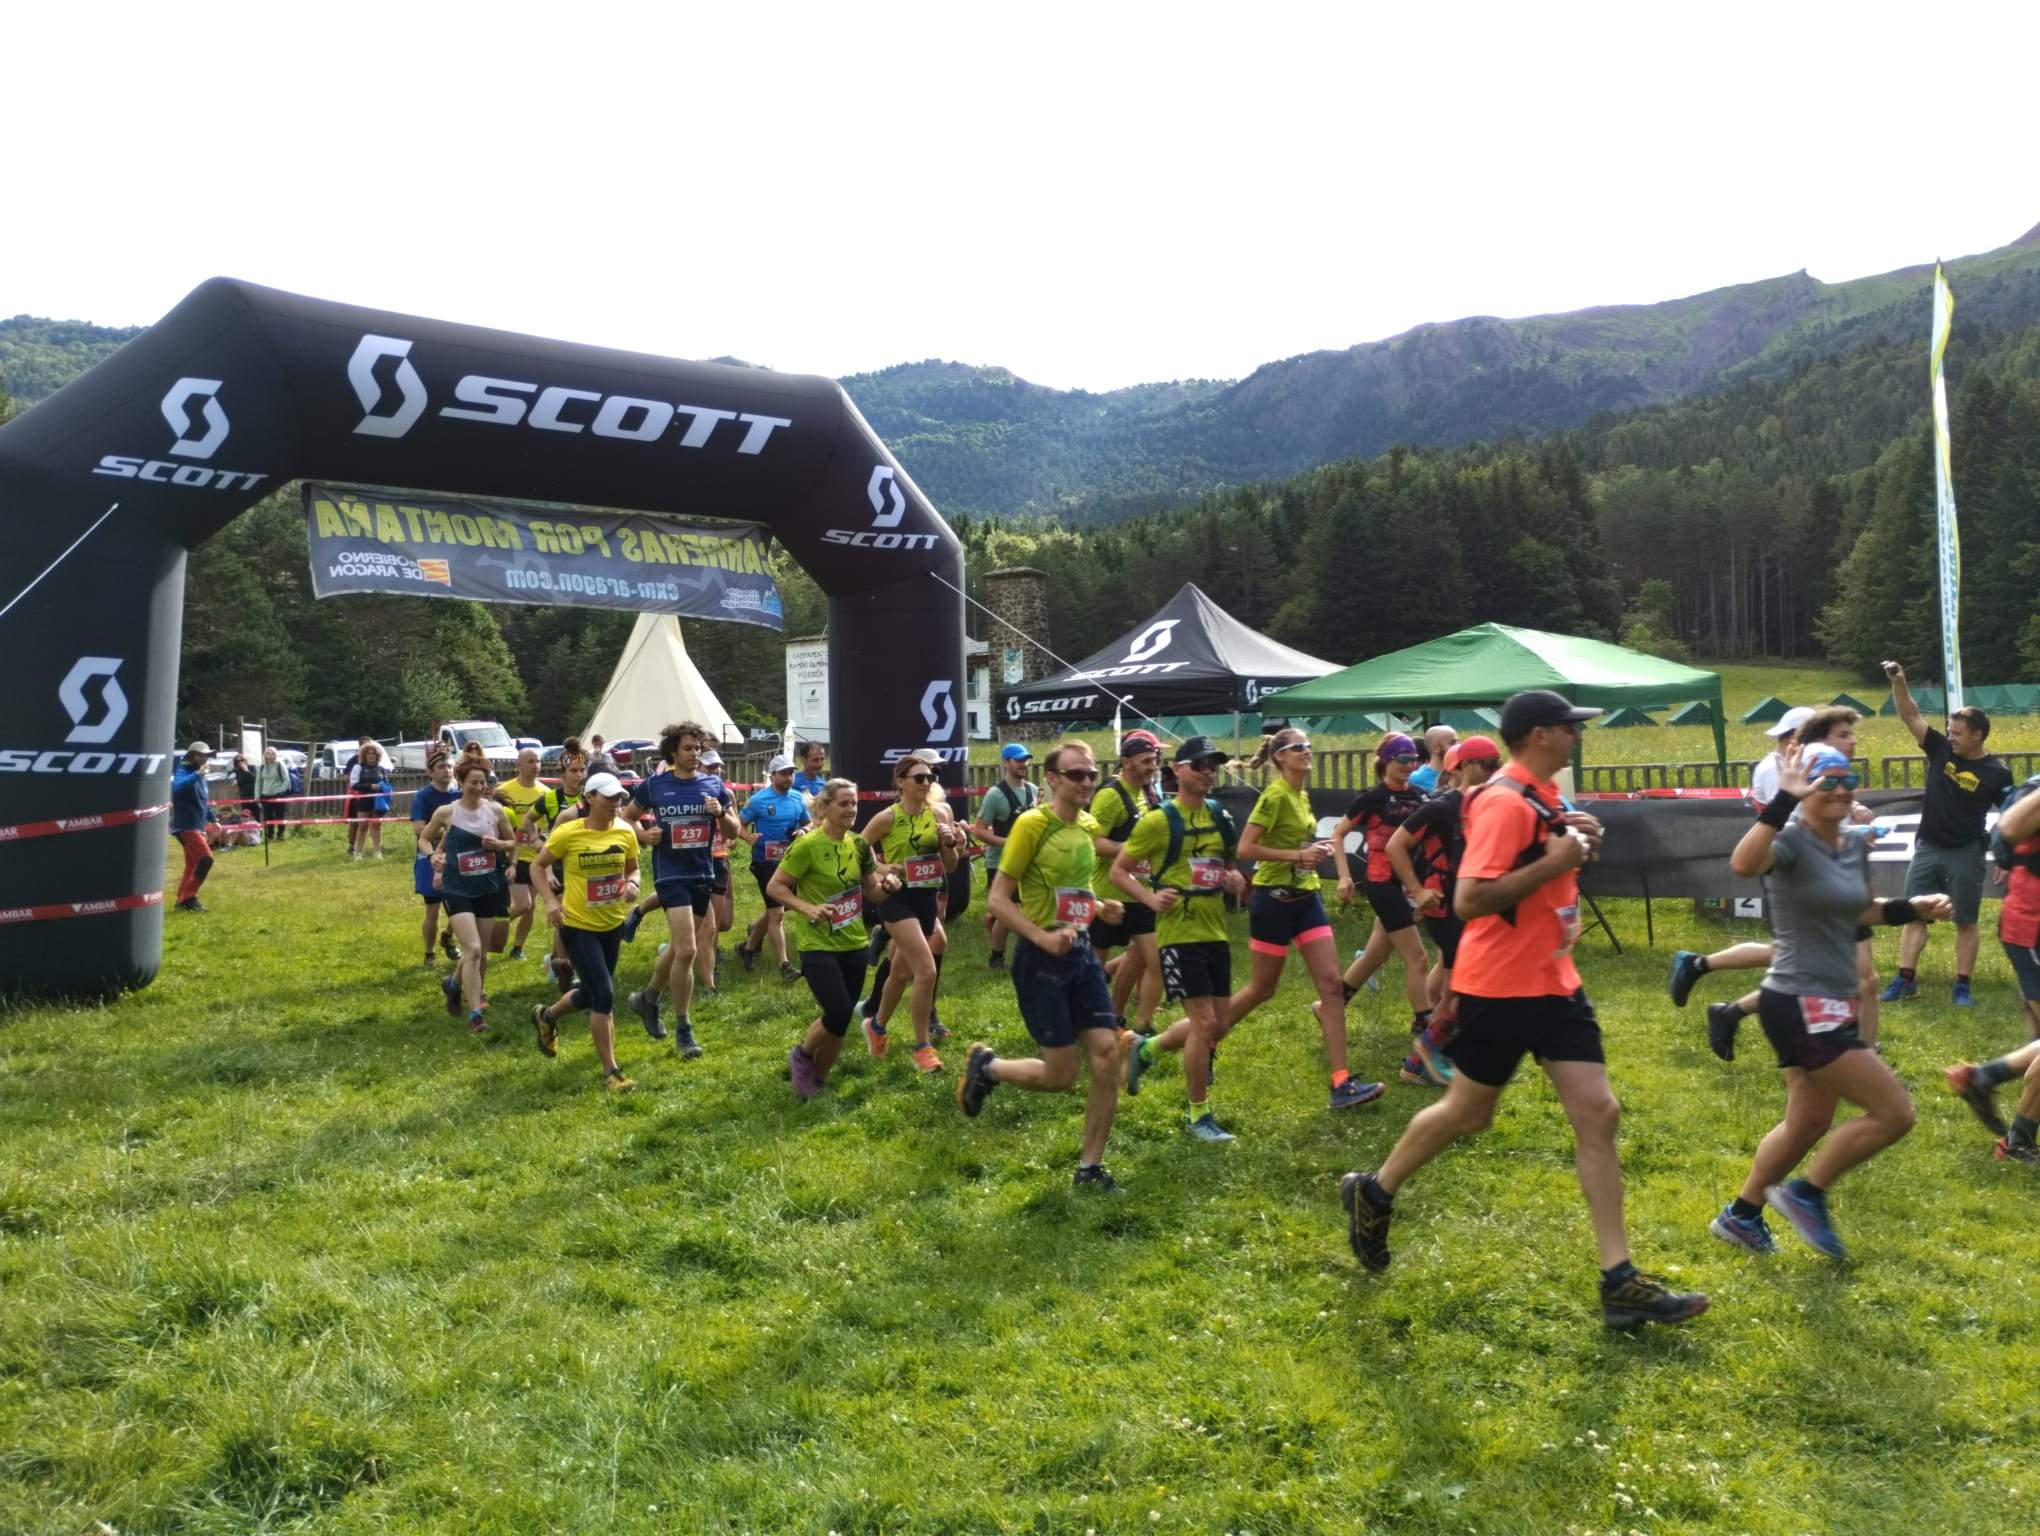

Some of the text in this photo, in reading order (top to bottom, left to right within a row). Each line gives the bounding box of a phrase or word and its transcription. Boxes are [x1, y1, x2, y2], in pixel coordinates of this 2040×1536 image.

[438, 374, 792, 456] SCOTT
[92, 455, 269, 492] SCOTT
[820, 529, 939, 550] SCOTT
[1063, 661, 1191, 682] SCOTT
[1023, 694, 1099, 714] SCOTT
[0, 750, 166, 774] SCOTT
[659, 804, 706, 816] DOLPHI
[67, 816, 104, 829] AMBAR
[681, 828, 703, 840] 237
[467, 856, 488, 868] 295
[915, 864, 936, 877] 202
[596, 883, 618, 897] 230
[82, 900, 117, 911] AMBAR
[838, 898, 858, 916] 286
